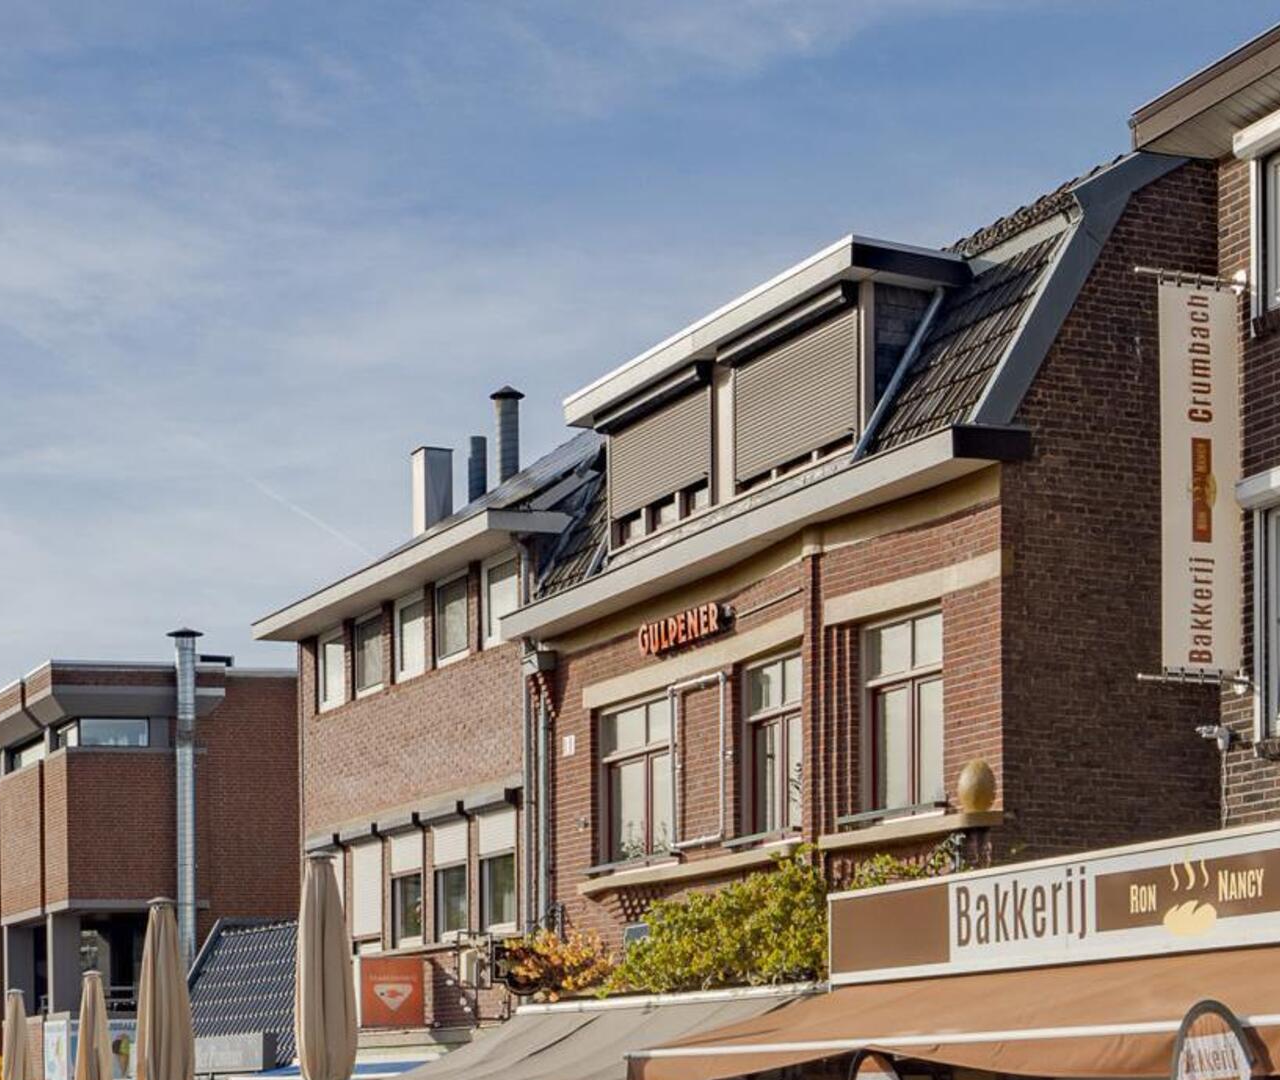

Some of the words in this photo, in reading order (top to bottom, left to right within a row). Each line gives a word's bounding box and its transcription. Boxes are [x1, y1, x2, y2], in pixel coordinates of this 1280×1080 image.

[1187, 294, 1213, 424] Crumbach
[638, 602, 719, 656] GULPENER
[1189, 557, 1216, 664] Bakkerij
[956, 866, 1087, 947] Bakkerij
[1129, 883, 1157, 914] RON
[1218, 868, 1265, 902] NANCY
